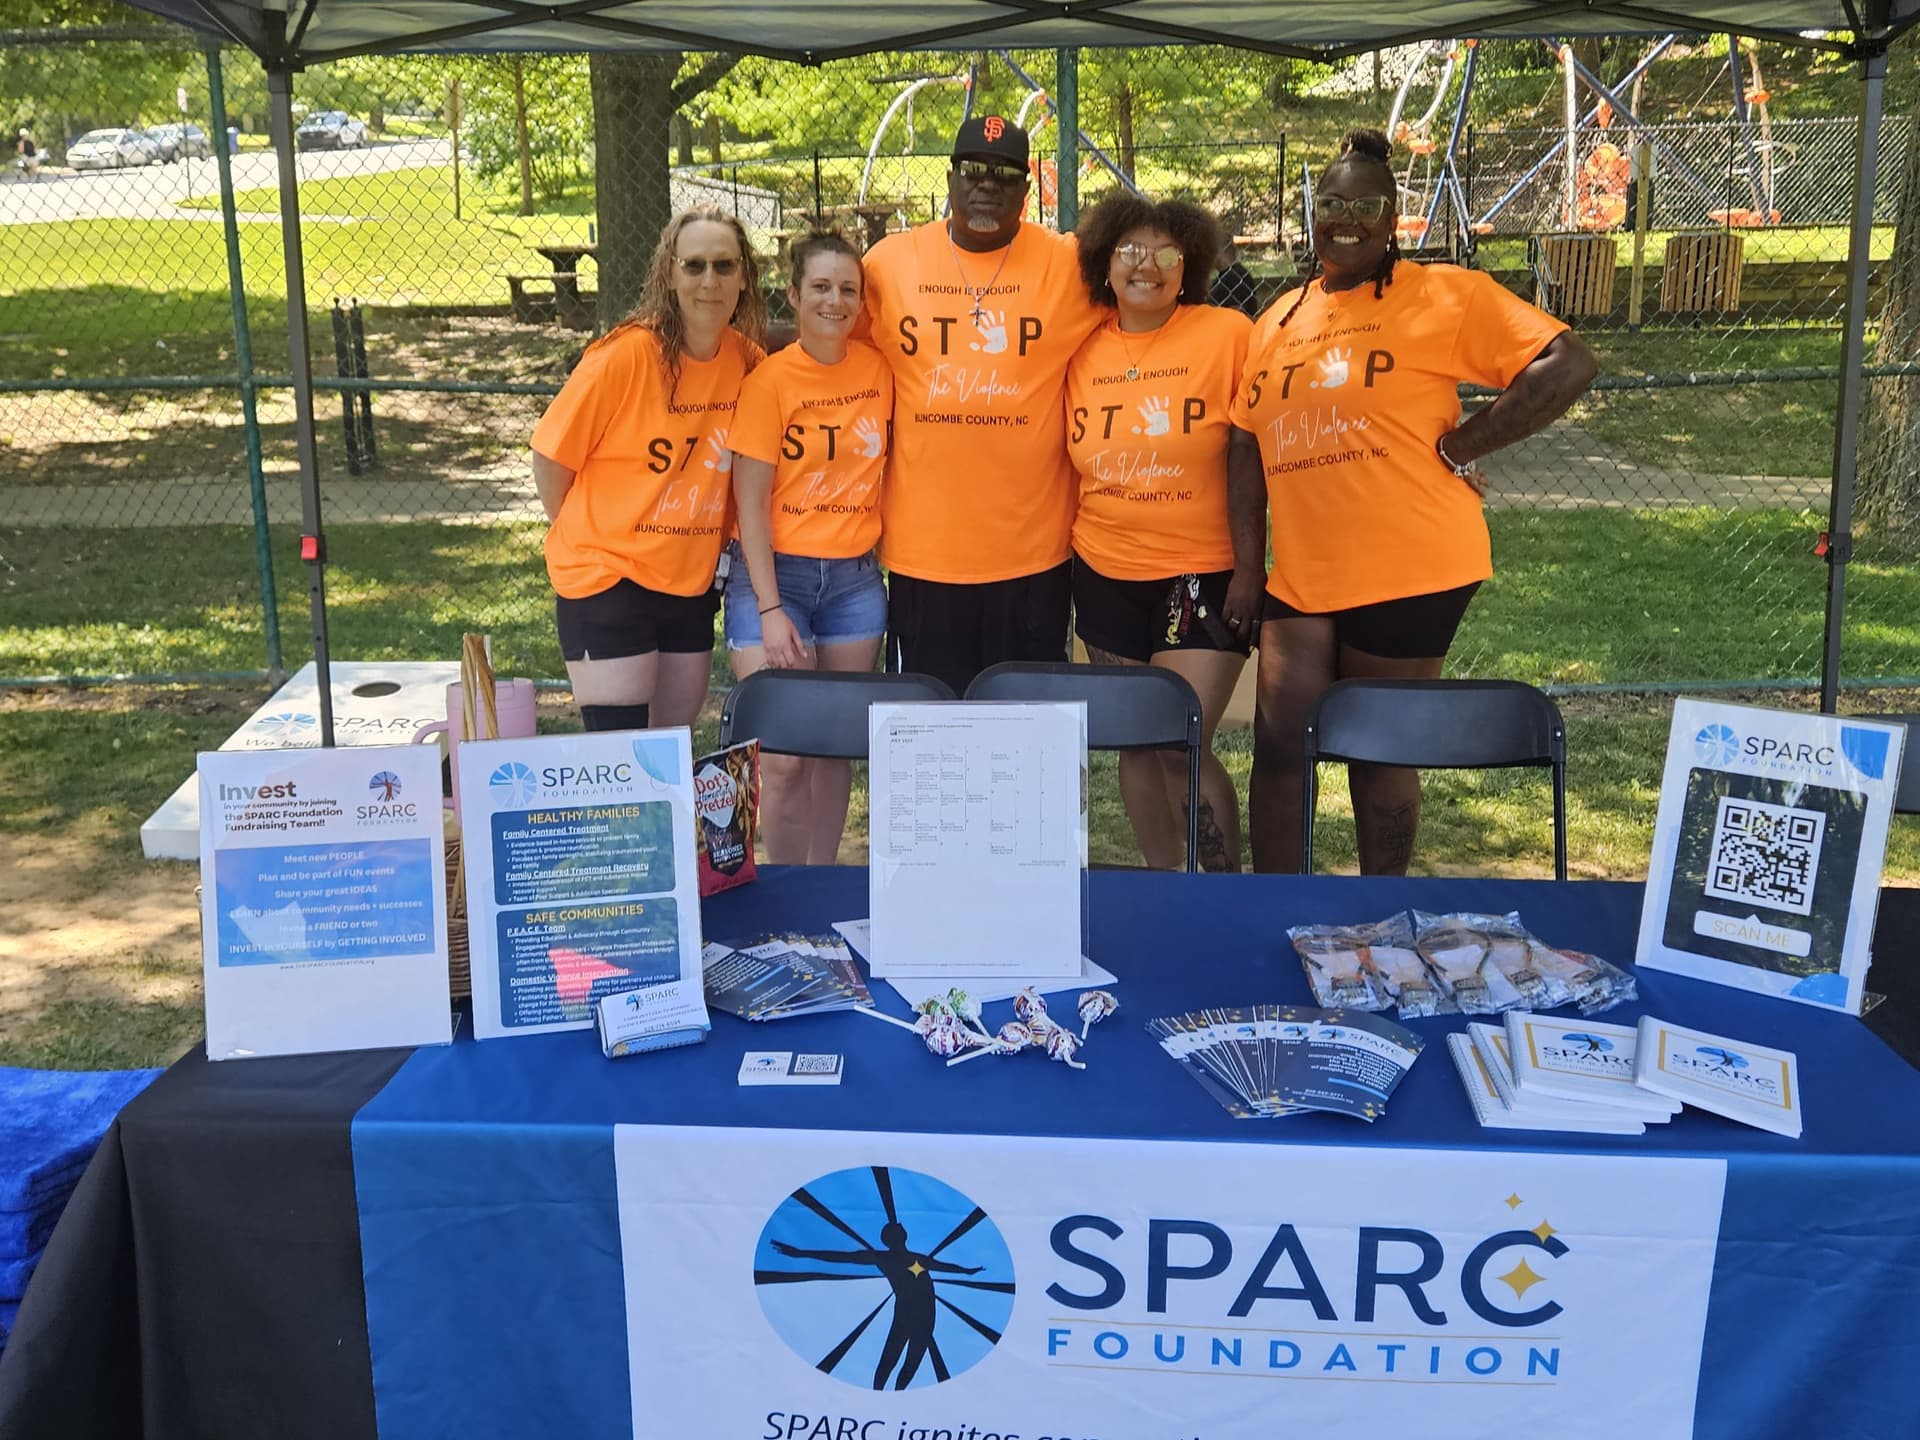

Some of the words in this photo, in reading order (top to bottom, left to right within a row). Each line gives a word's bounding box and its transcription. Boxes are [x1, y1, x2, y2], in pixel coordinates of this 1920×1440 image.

[984, 115, 1005, 143] SF
[918, 284, 961, 295] ENOUGH
[976, 284, 1020, 296] ENOUGH
[1093, 375, 1129, 385] ENOUGH
[1143, 366, 1189, 380] ENOUGH
[924, 363, 950, 408] The
[957, 367, 1022, 406] Violence
[844, 389, 880, 405] ENOUGH
[915, 413, 963, 424] BUNCOMBE
[966, 414, 1014, 427] COUNTY,
[1016, 415, 1029, 425] NC
[1267, 410, 1297, 463] The
[1300, 405, 1371, 449] Violence
[1317, 449, 1369, 467] COUNTY,
[1372, 447, 1389, 459] NC
[1118, 451, 1184, 487] Violence
[1128, 490, 1175, 501] COUNTY,
[1177, 490, 1192, 500] NC
[1743, 736, 1835, 767] SPARC
[542, 763, 632, 787] SPARC
[1742, 758, 1832, 776] FOUNDATION
[219, 781, 297, 801] Invest
[543, 786, 633, 798] FOUNDATION
[694, 773, 729, 794] Dot's
[252, 801, 298, 810] community
[299, 800, 308, 808] by
[310, 799, 337, 807] joining
[357, 803, 417, 819] SPARC
[225, 813, 242, 821] the
[244, 810, 281, 820] SPARC
[283, 808, 343, 818] Foundation
[527, 810, 583, 824] HEALTHY
[586, 806, 640, 820] FAMILIES
[225, 820, 288, 831] Fundraising
[290, 819, 325, 829] Team!!
[503, 830, 529, 840] Family
[531, 826, 567, 837] Centered
[568, 824, 609, 834] Treatment
[284, 855, 307, 864] Meet
[309, 854, 329, 862] new
[329, 851, 365, 861] PEOPLE
[258, 873, 278, 882] Plan
[280, 872, 297, 880] and
[299, 871, 311, 880] be
[312, 871, 332, 881] part
[333, 869, 342, 878] of
[344, 868, 363, 877] FUN
[365, 866, 396, 875] events
[506, 871, 532, 881] Family
[533, 868, 569, 879] Centered
[570, 864, 613, 876] Treatment
[613, 863, 649, 873] Recovery
[274, 889, 300, 898] Share
[303, 888, 323, 898] your
[325, 887, 350, 898] great
[351, 884, 377, 894] IDEAS
[344, 902, 370, 911] needs
[379, 901, 423, 910] successes
[526, 911, 556, 924] SAFE
[560, 904, 644, 921] COMMUNITIES
[314, 920, 348, 931] FRIEND
[350, 921, 360, 929] or
[361, 920, 378, 928] two
[544, 924, 567, 934] Team
[1713, 920, 1761, 941] SCAN
[325, 940, 336, 950] by
[338, 936, 379, 947] GETTING
[380, 933, 426, 944] INVOLVED
[510, 975, 546, 987] Domestic
[645, 987, 679, 1002] SPARC
[1543, 1047, 1633, 1066] SPARC
[1673, 1053, 1776, 1090] SPARC
[1045, 1214, 1570, 1328] SPARC
[1047, 1328, 1560, 1377] FOUNDATION
[763, 1412, 885, 1440] SPARC
